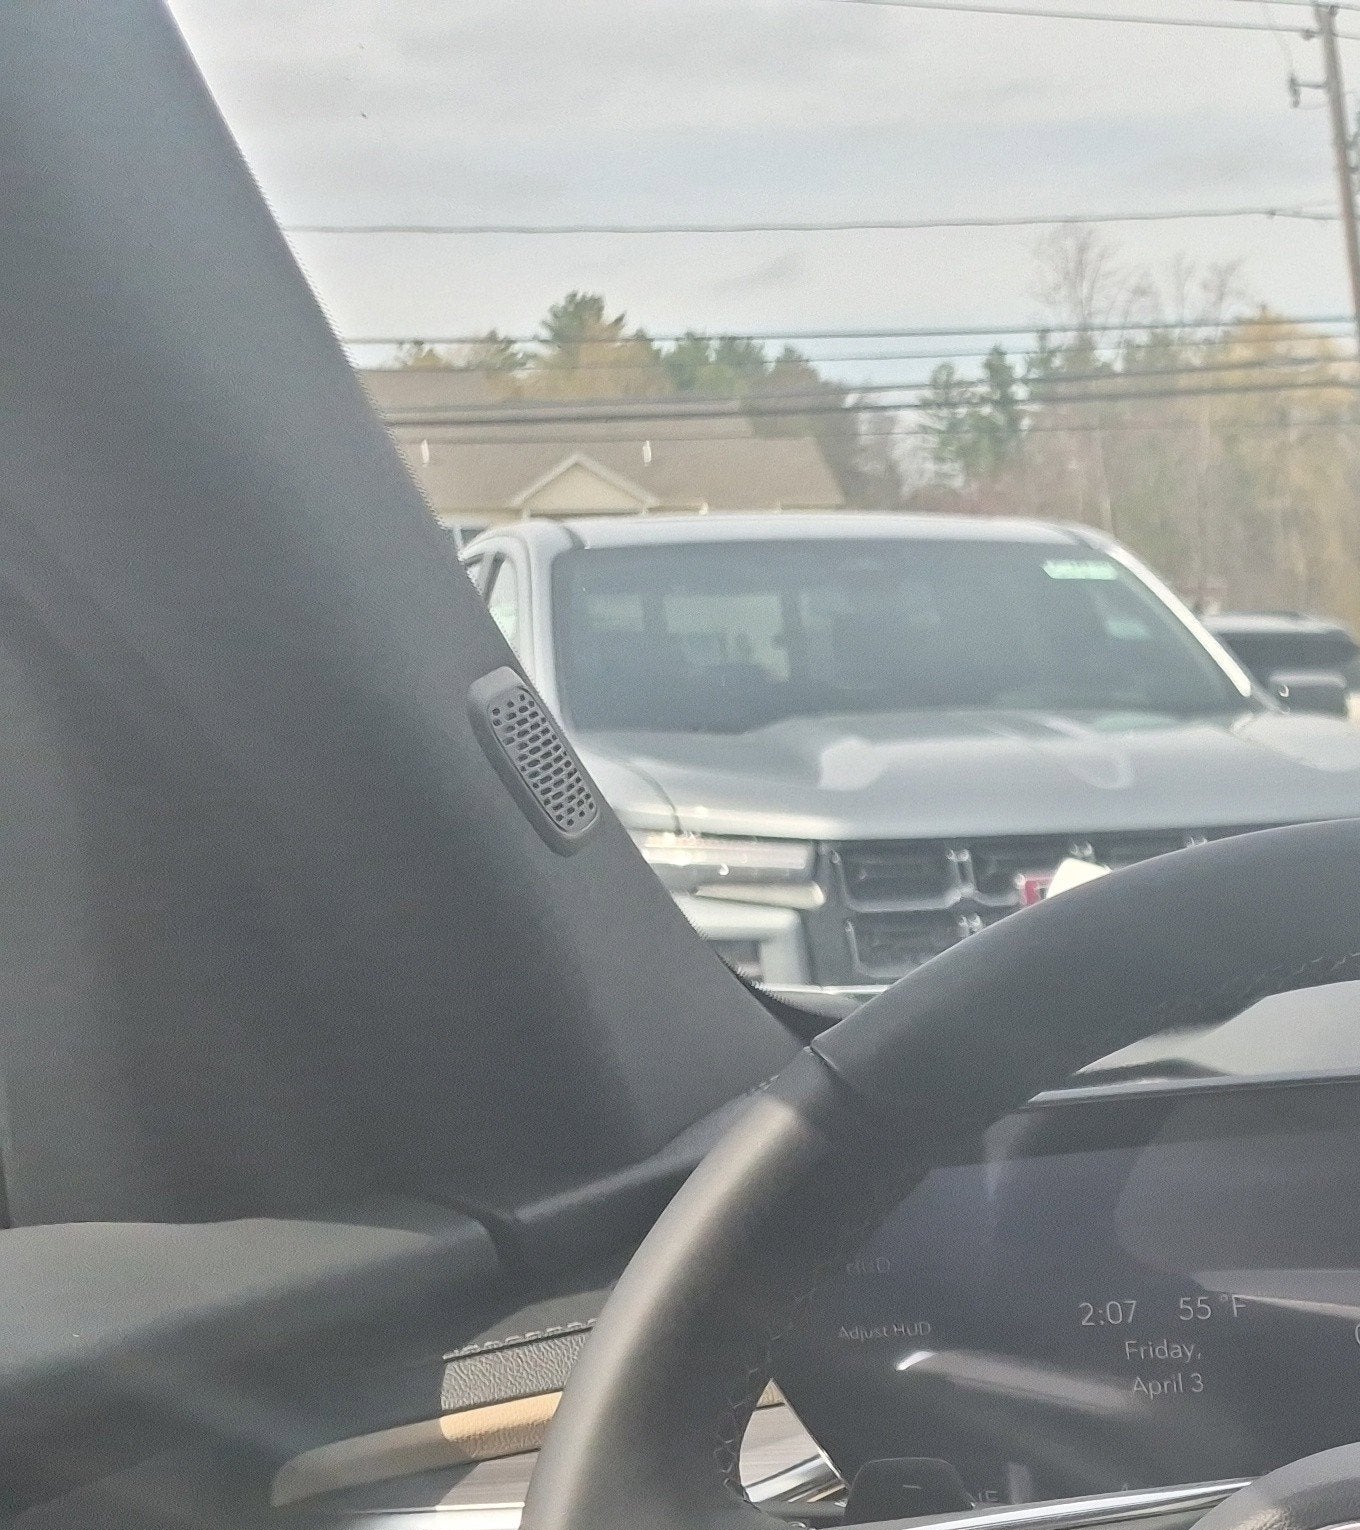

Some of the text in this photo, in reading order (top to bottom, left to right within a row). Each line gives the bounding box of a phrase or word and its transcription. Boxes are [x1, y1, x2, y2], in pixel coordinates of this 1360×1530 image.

[1079, 1300, 1137, 1327] 2:07
[1178, 1297, 1212, 1321] 55
[1124, 1338, 1202, 1364] Friday,
[1132, 1373, 1205, 1400] April 3
